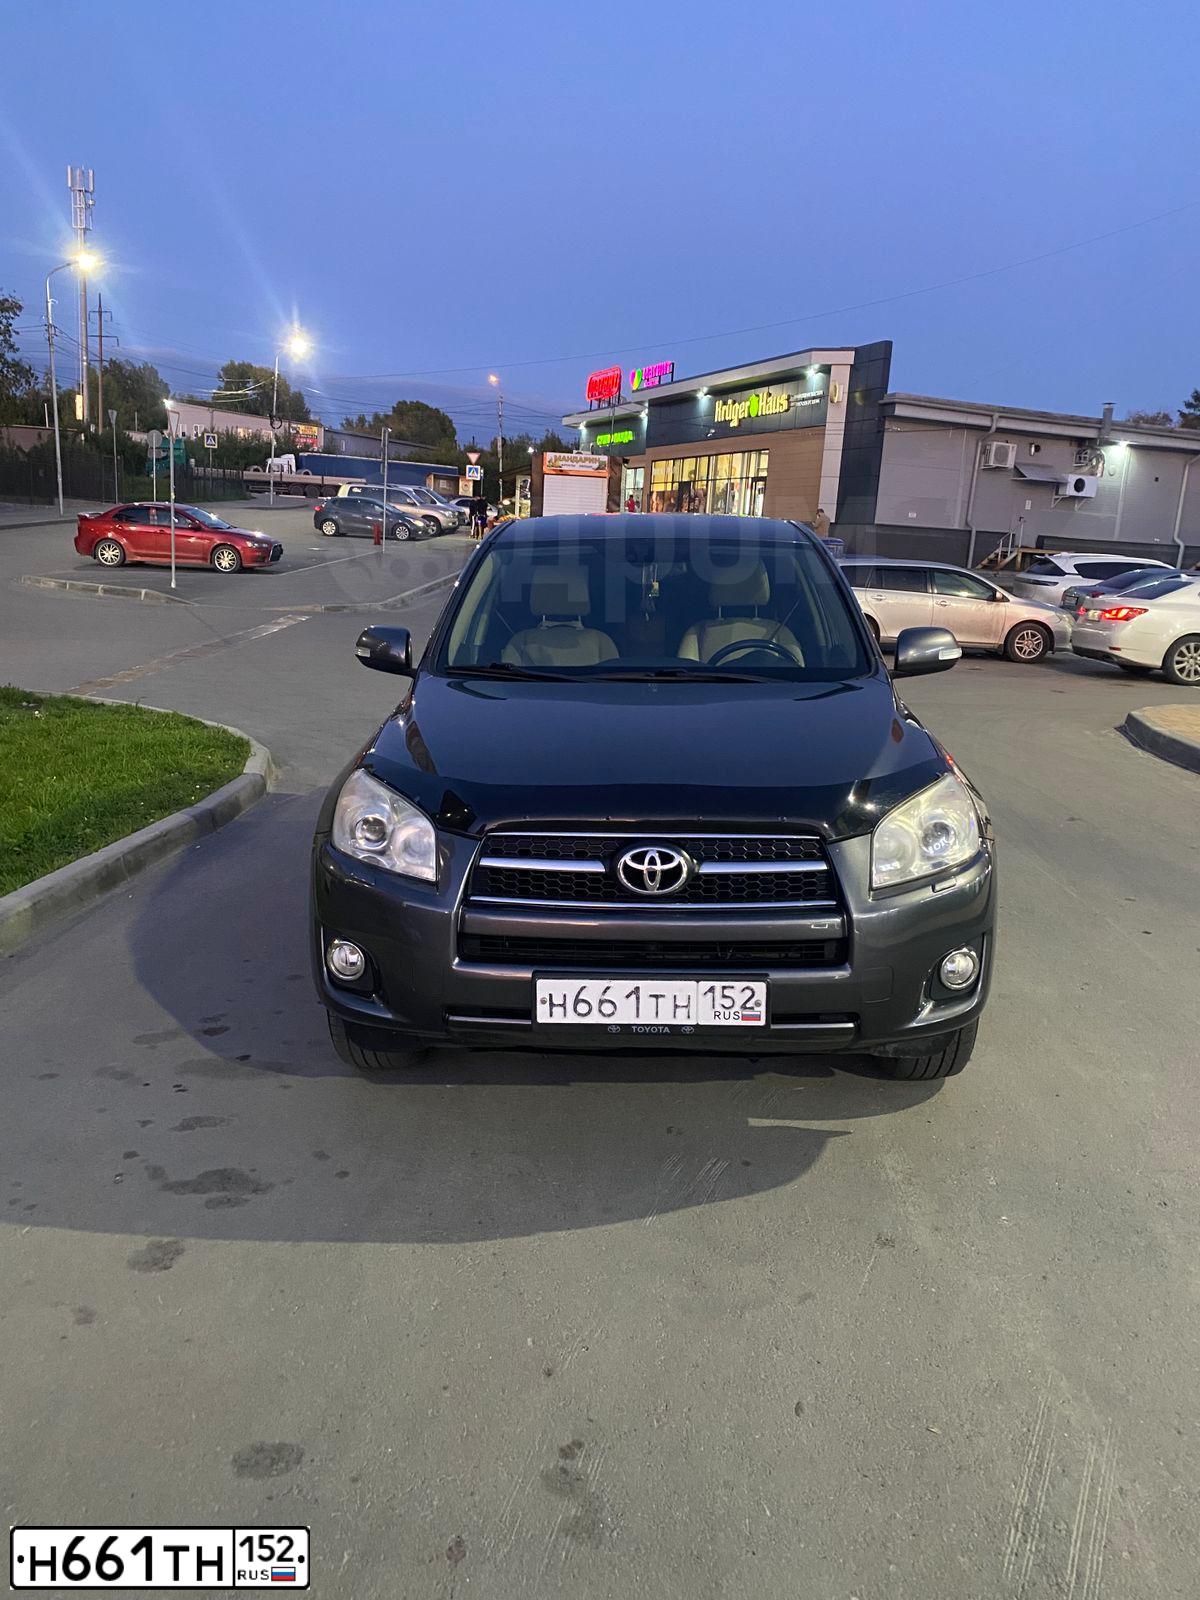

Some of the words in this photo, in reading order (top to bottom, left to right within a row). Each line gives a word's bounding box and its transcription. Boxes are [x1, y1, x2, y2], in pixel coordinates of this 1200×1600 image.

[714, 398, 750, 427] Krüger
[758, 391, 789, 416] Haus
[703, 985, 756, 1010] 152
[713, 1010, 741, 1021] RUS
[631, 1026, 671, 1034] TOYOTA
